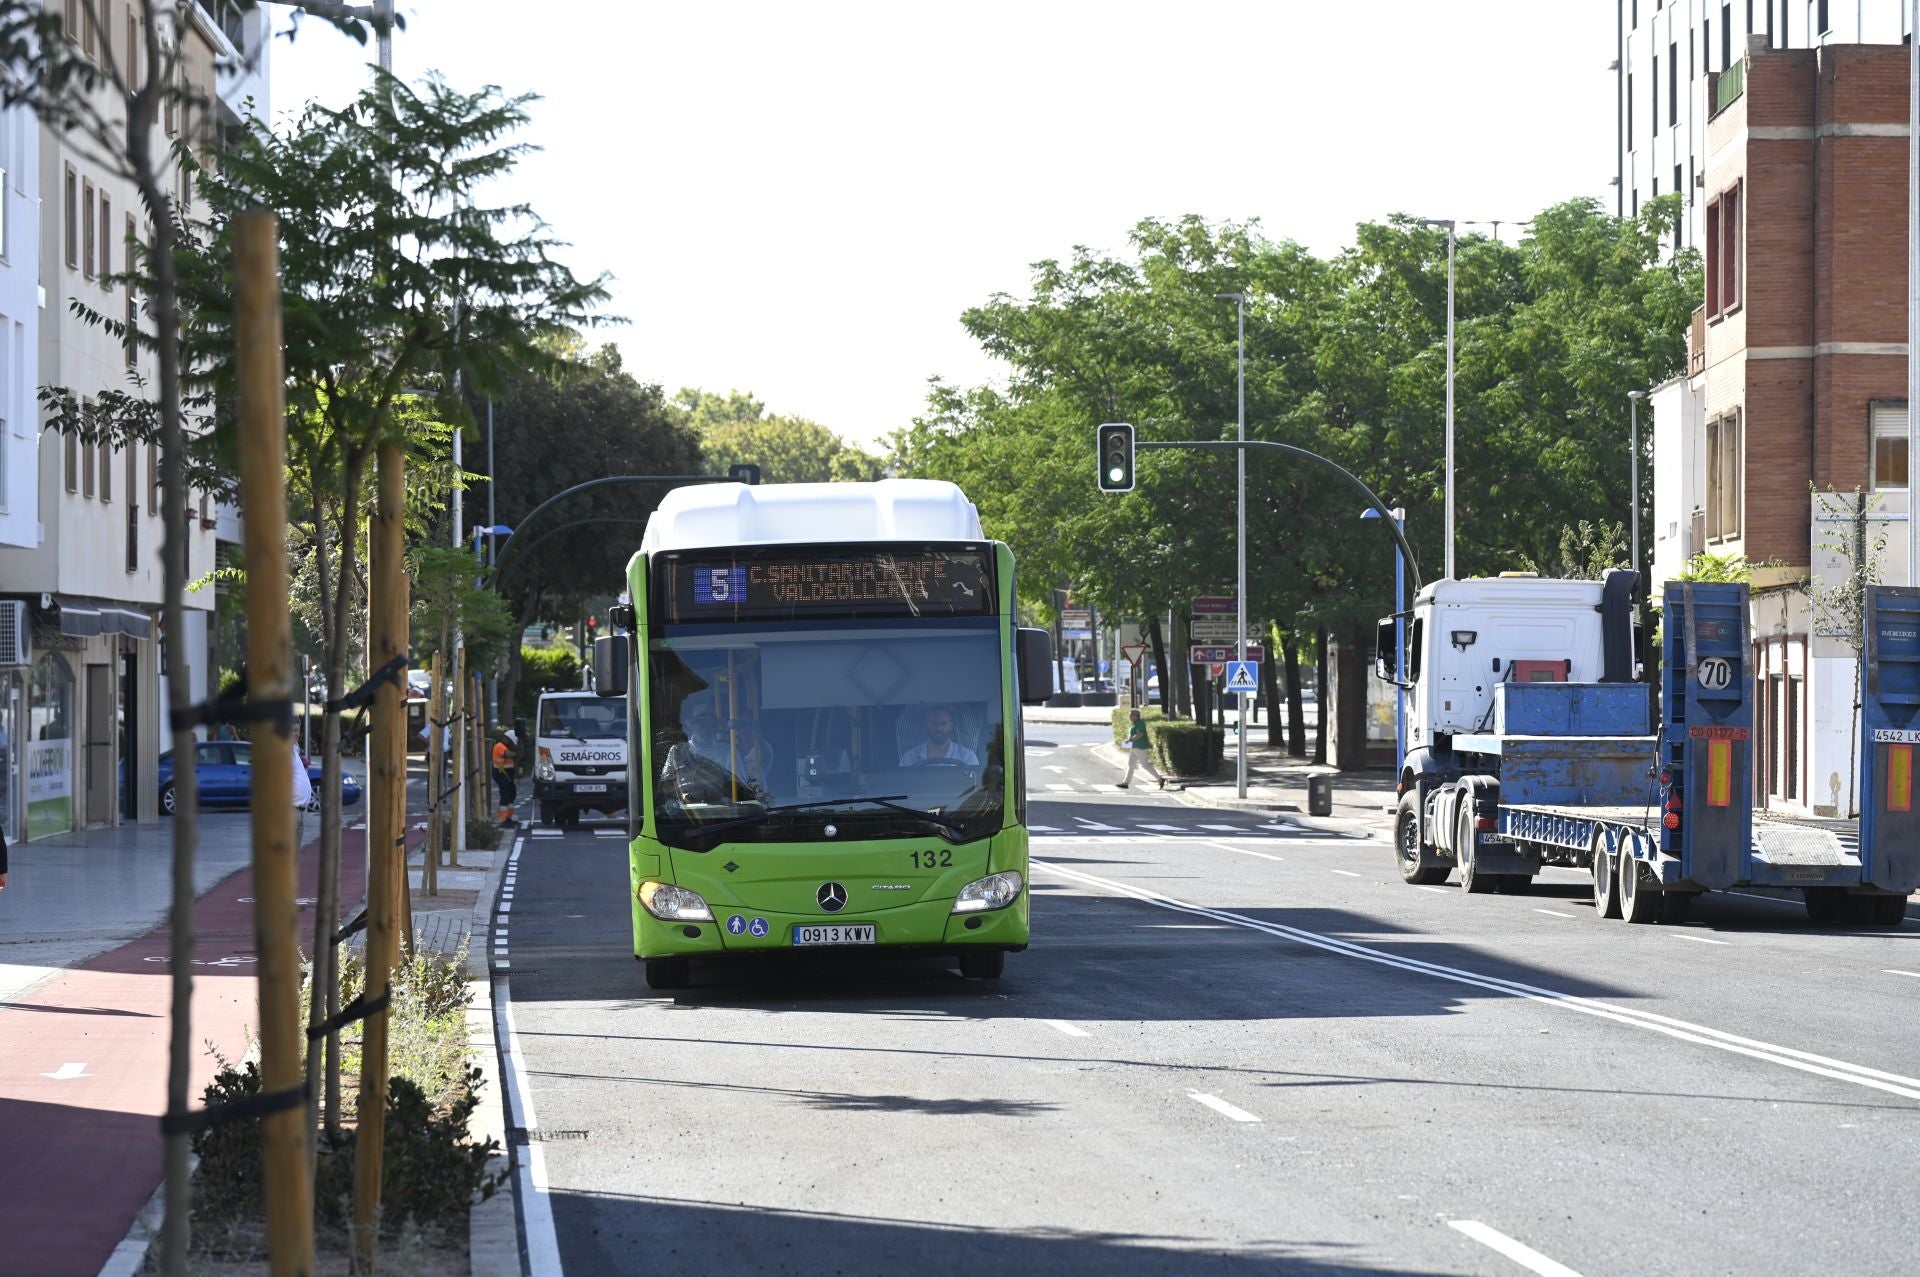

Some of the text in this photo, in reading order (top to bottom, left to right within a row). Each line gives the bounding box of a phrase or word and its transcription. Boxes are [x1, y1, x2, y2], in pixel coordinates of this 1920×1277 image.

[711, 567, 729, 600] 5
[773, 580, 926, 601] VALDEOLLEROS
[1705, 661, 1727, 686] 70
[1876, 731, 1903, 741] 4542
[560, 749, 622, 761] SEMÁFOROS
[910, 850, 953, 869] 132
[803, 926, 872, 942] 0913 KWV
